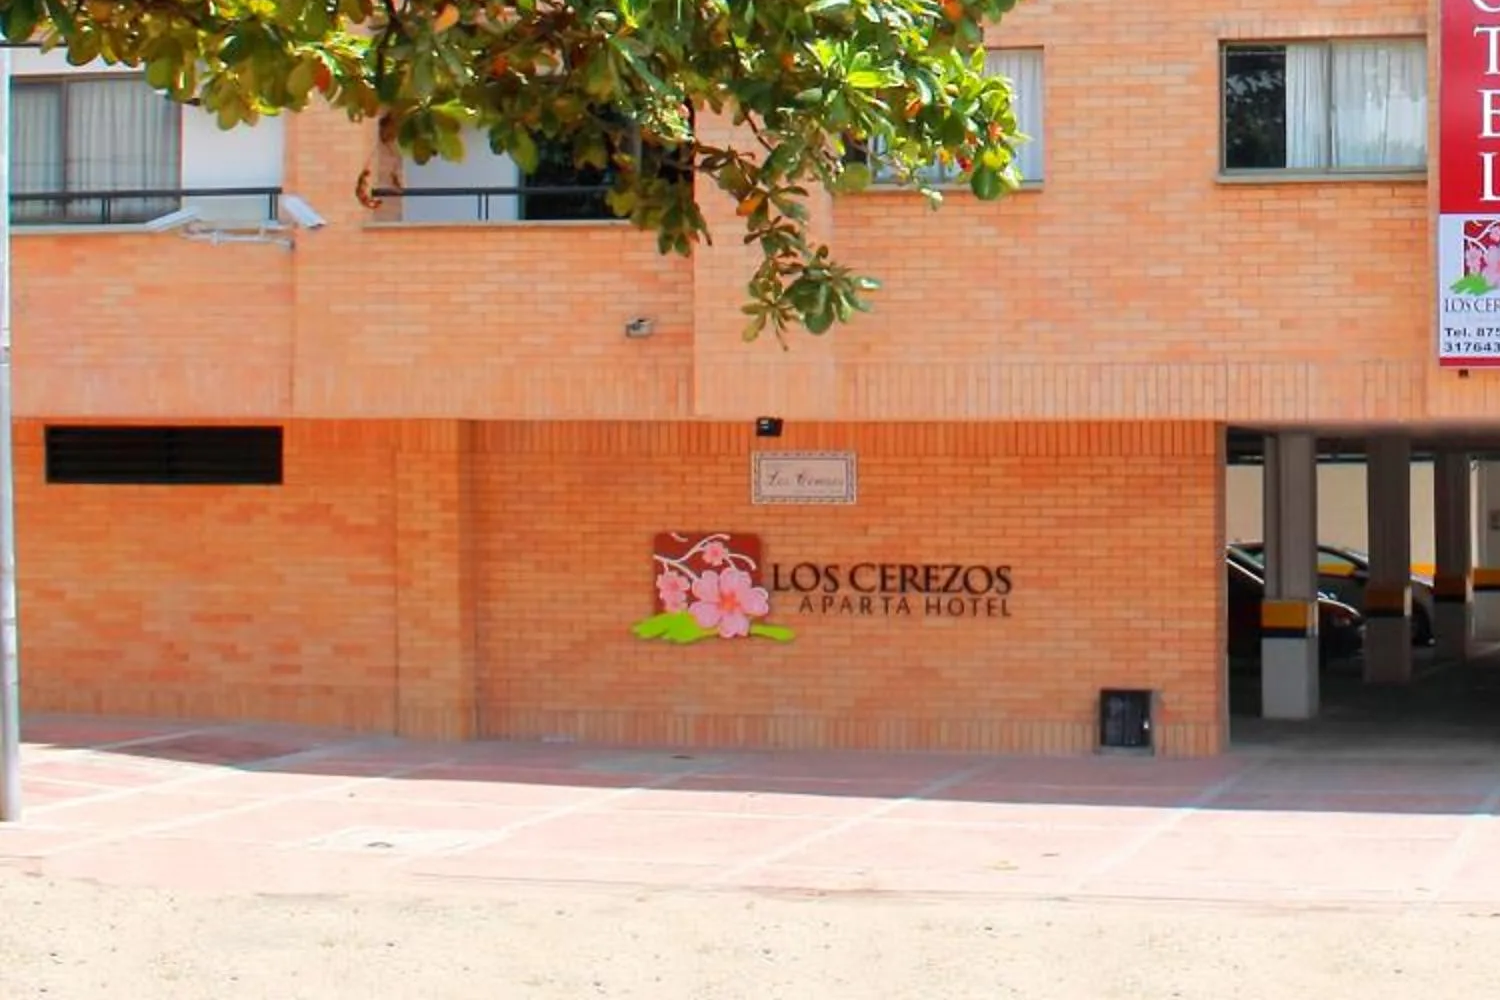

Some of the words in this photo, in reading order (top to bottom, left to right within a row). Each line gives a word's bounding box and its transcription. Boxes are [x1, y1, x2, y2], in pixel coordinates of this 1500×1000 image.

[1445, 297, 1471, 313] LOS
[1445, 327, 1471, 337] Tel.
[772, 562, 839, 593] LOS
[848, 563, 1012, 595] CEREZOS
[800, 596, 911, 615] APARTA
[925, 598, 1012, 617] HOTEL
